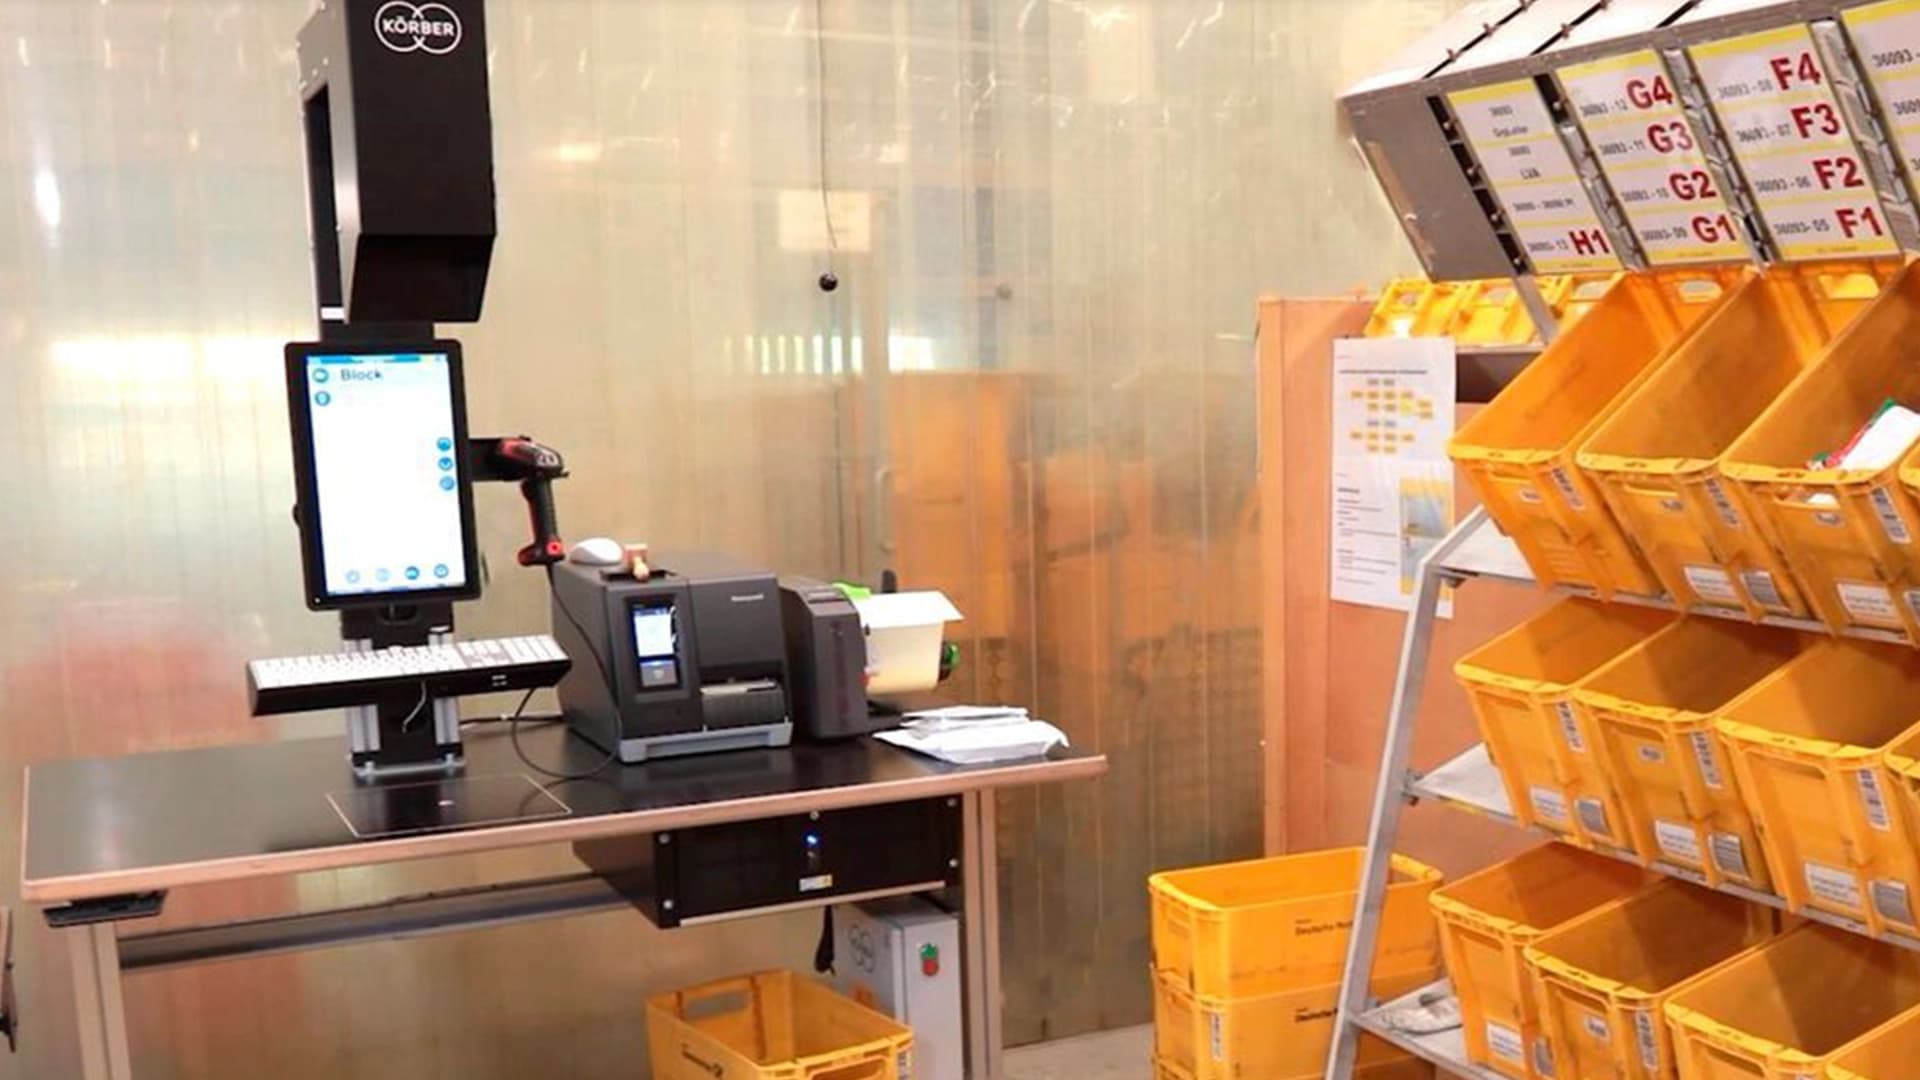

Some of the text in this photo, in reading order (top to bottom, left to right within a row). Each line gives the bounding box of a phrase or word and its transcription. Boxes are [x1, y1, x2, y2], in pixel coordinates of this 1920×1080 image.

[383, 16, 454, 37] KÖRBER
[1770, 53, 1821, 91] F4
[1871, 48, 1914, 68] 36093
[1626, 75, 1673, 110] G4
[1790, 104, 1840, 139] F3
[1647, 122, 1694, 154] G3
[1669, 171, 1717, 201] G2
[1812, 157, 1864, 190] F2
[1691, 214, 1736, 243] G1
[1835, 206, 1883, 239] F1
[1568, 229, 1610, 255] H1
